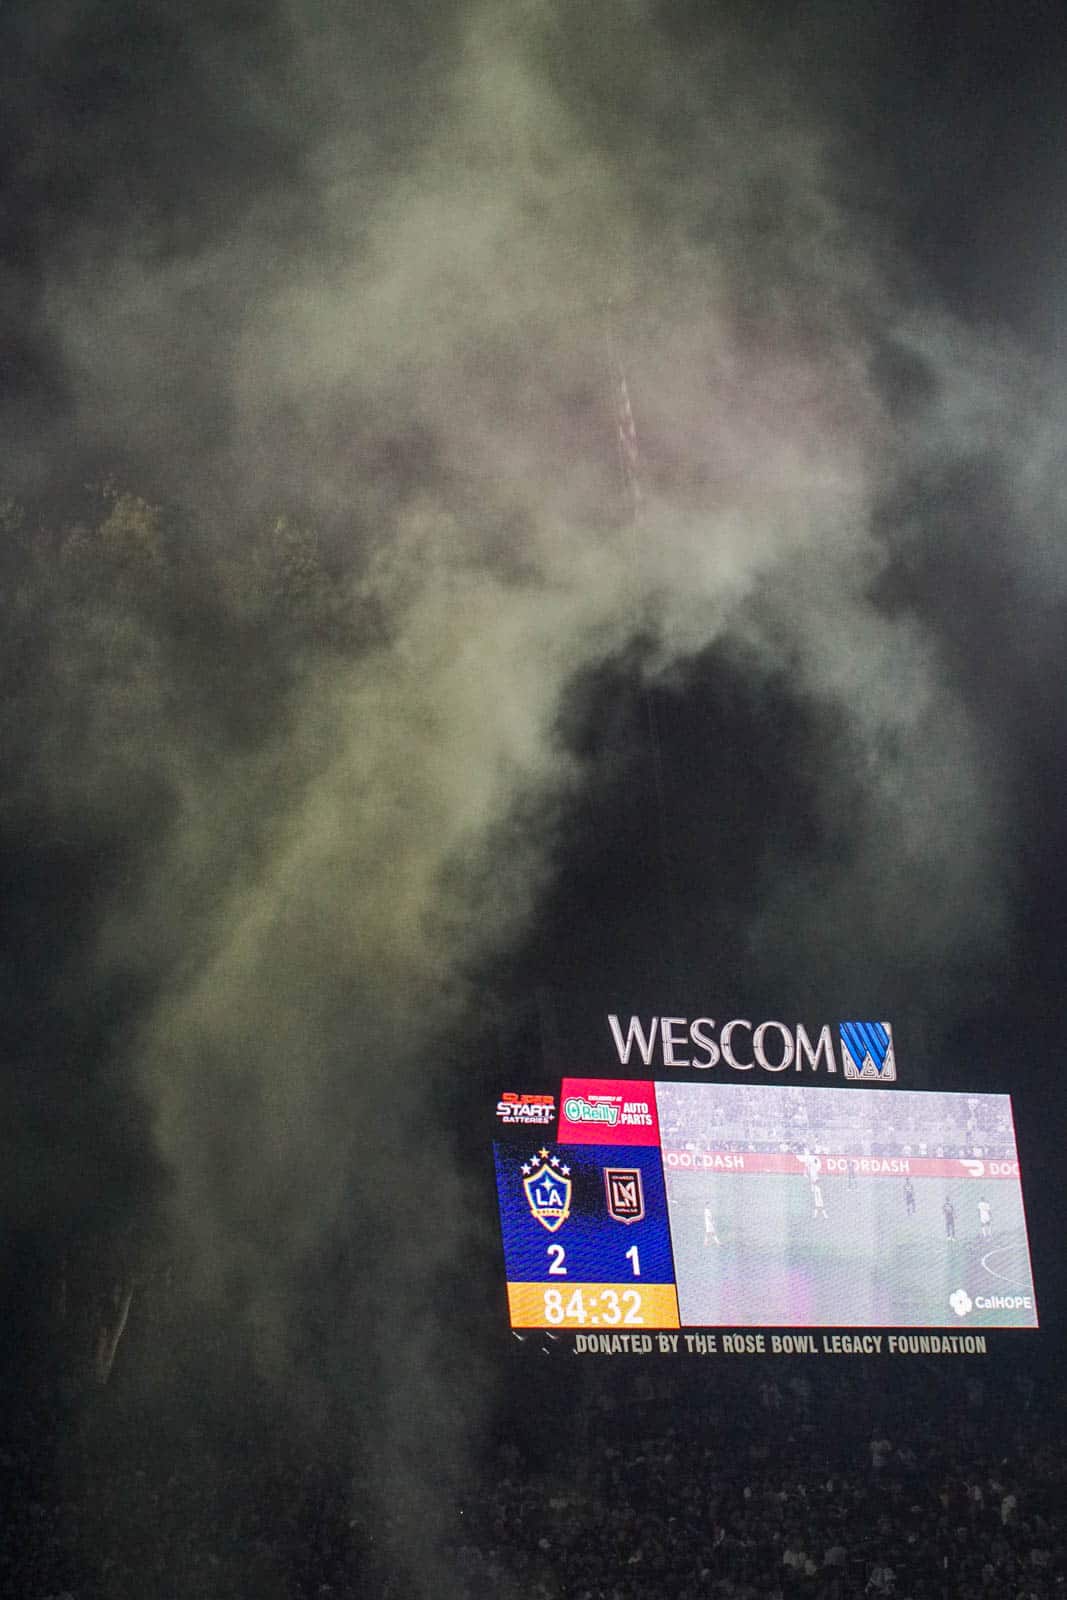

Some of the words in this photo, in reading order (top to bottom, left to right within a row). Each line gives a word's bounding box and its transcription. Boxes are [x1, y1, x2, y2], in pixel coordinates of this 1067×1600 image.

[608, 1014, 837, 1073] WESCOM
[496, 1102, 555, 1116] START
[565, 1099, 619, 1126] O'Reilly
[623, 1103, 648, 1114] AUTO
[502, 1116, 549, 1124] BATTERIES
[621, 1114, 652, 1125] PARTS
[535, 1188, 563, 1206] LA
[547, 1244, 567, 1275] 2
[626, 1245, 641, 1276] 1
[543, 1289, 644, 1325] 84:32
[975, 1296, 1033, 1309] CalHOPE
[575, 1334, 653, 1353] DONATED
[658, 1334, 680, 1353] BY
[684, 1334, 718, 1353] THE
[722, 1334, 765, 1353] ROSE
[771, 1334, 819, 1353] BOWL
[823, 1334, 883, 1353] LEGACY
[888, 1334, 987, 1353] FOUNDATION
